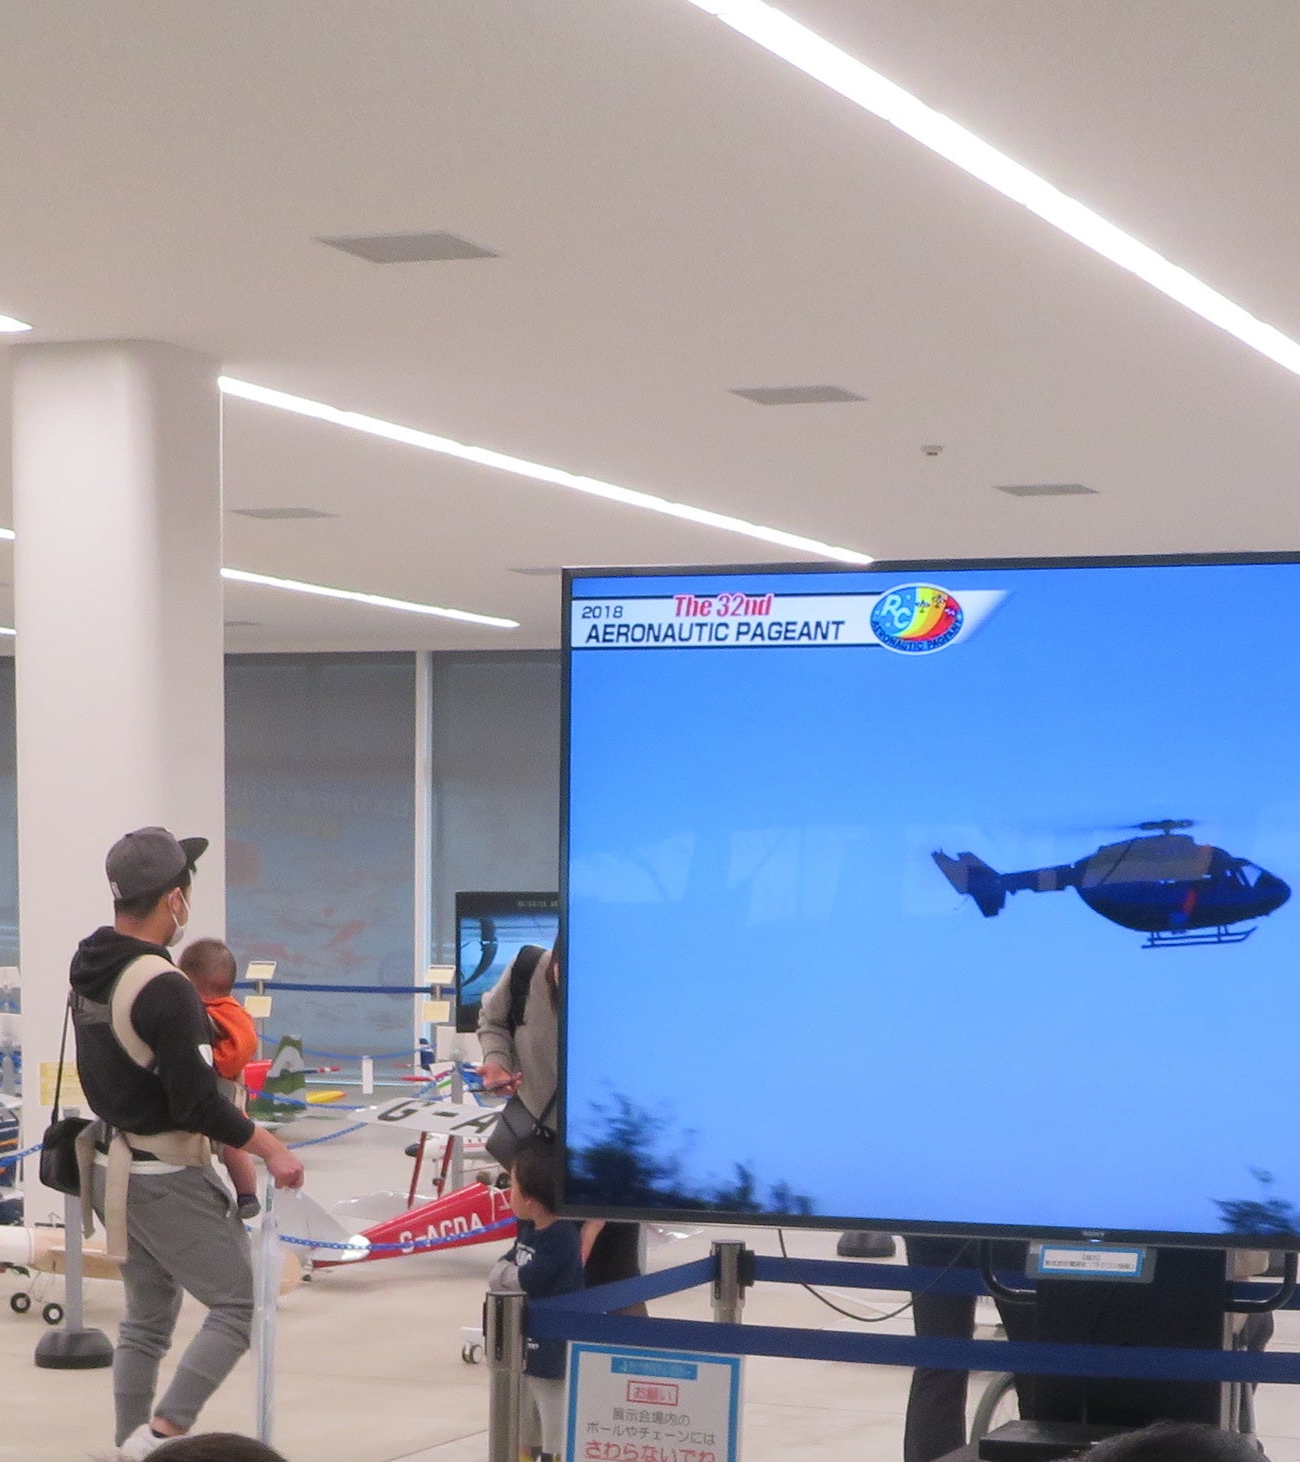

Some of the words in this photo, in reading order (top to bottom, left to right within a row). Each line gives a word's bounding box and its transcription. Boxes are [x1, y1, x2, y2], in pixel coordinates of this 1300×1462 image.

[581, 605, 624, 619] 2018
[674, 594, 712, 617] The
[716, 593, 773, 617] 32nd
[585, 622, 730, 643] AERONAUTIC
[735, 620, 846, 642] PAGEANT
